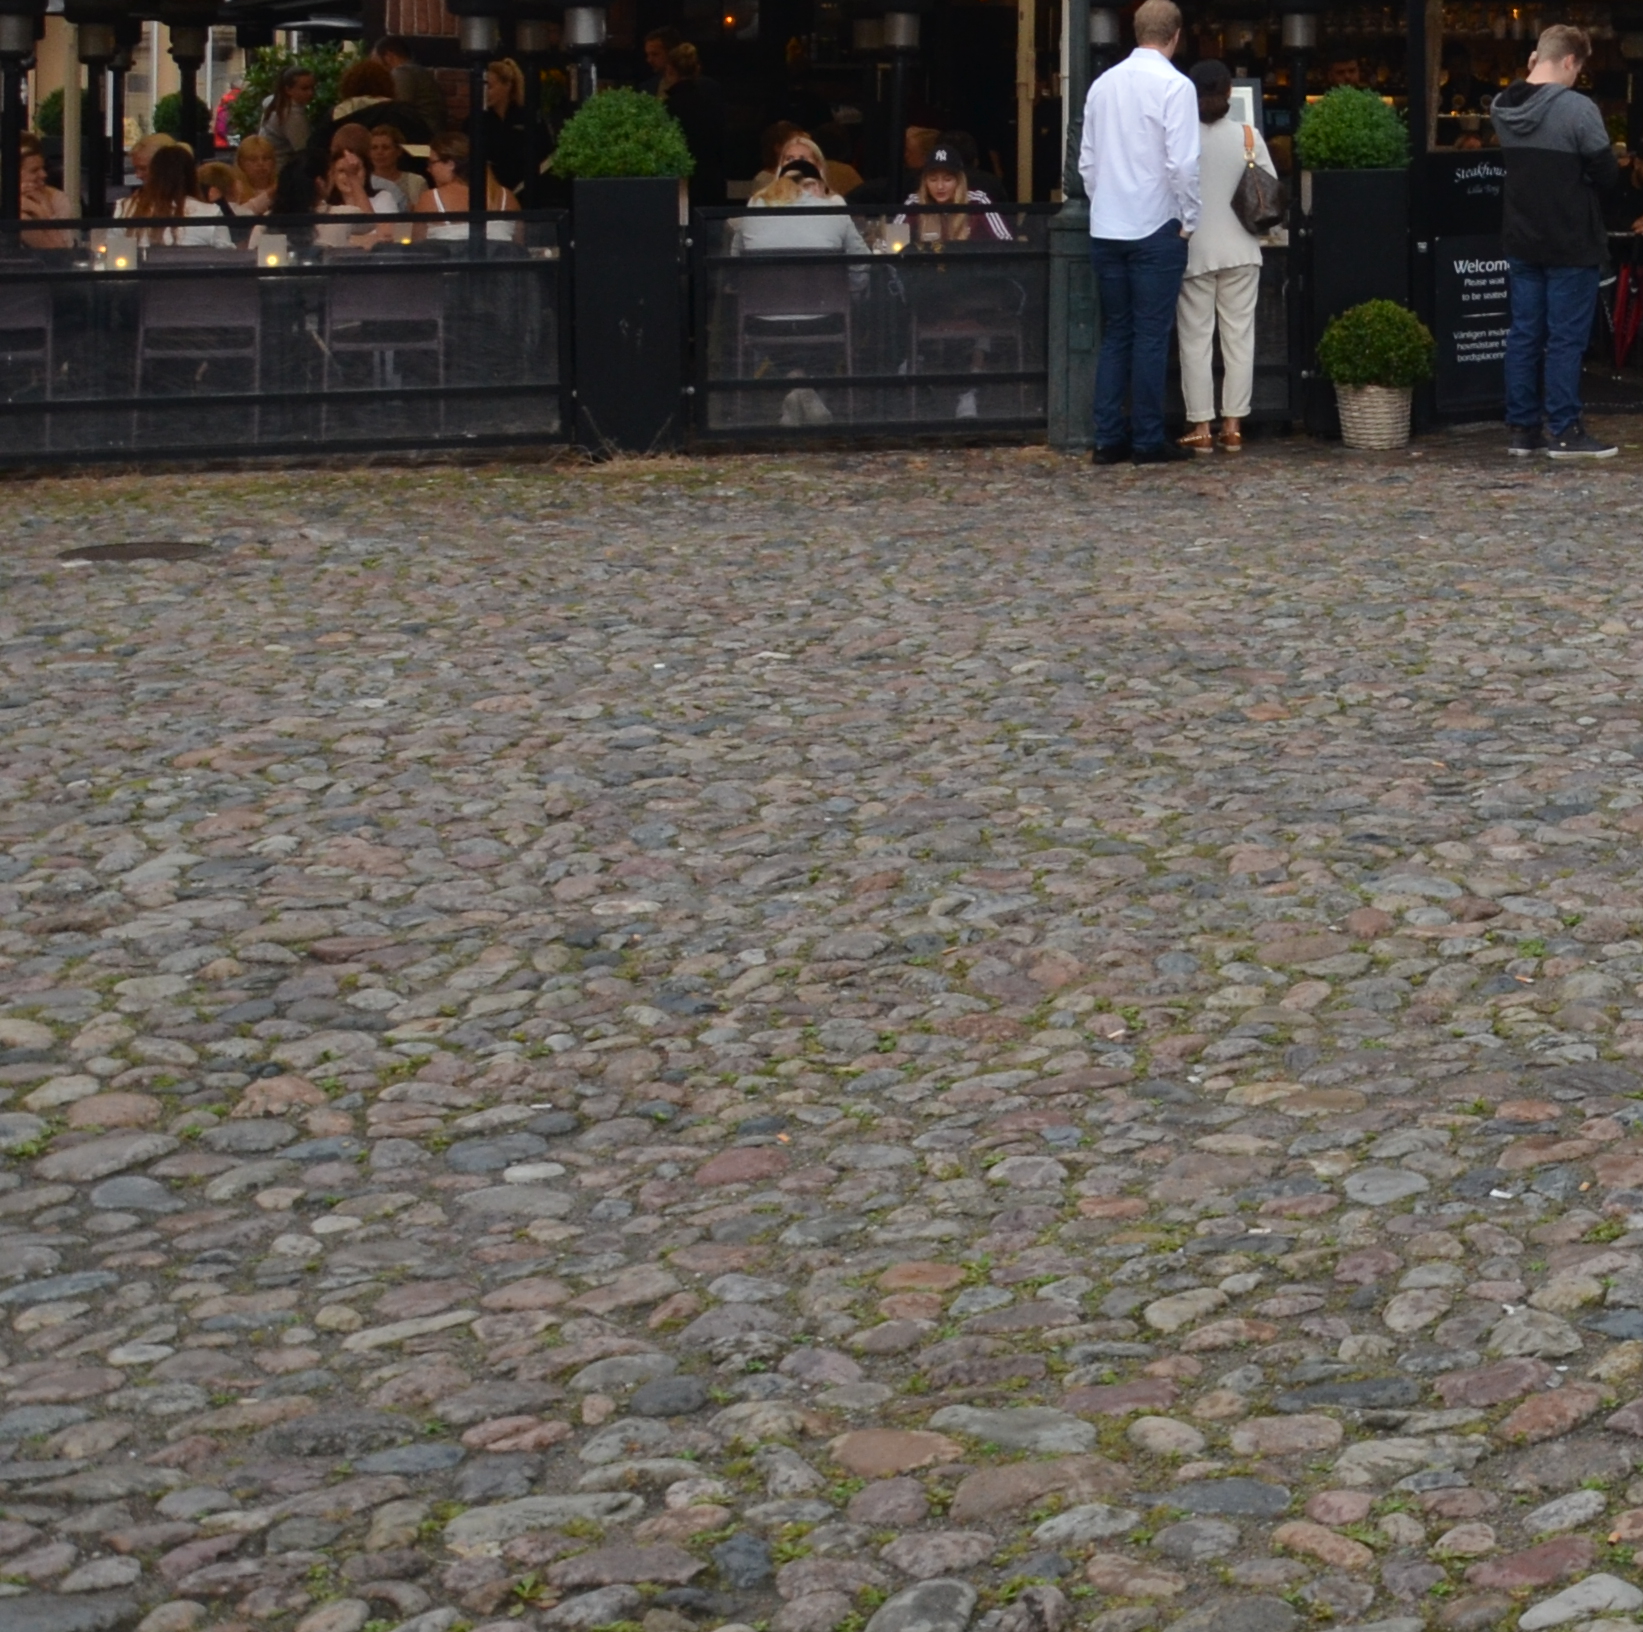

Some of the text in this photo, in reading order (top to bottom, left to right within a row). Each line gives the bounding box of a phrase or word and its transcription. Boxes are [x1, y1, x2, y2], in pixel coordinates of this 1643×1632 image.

[1453, 259, 1510, 274] Welcom
[1464, 278, 1488, 286] Please
[1461, 293, 1470, 301] to
[1471, 292, 1482, 300] be
